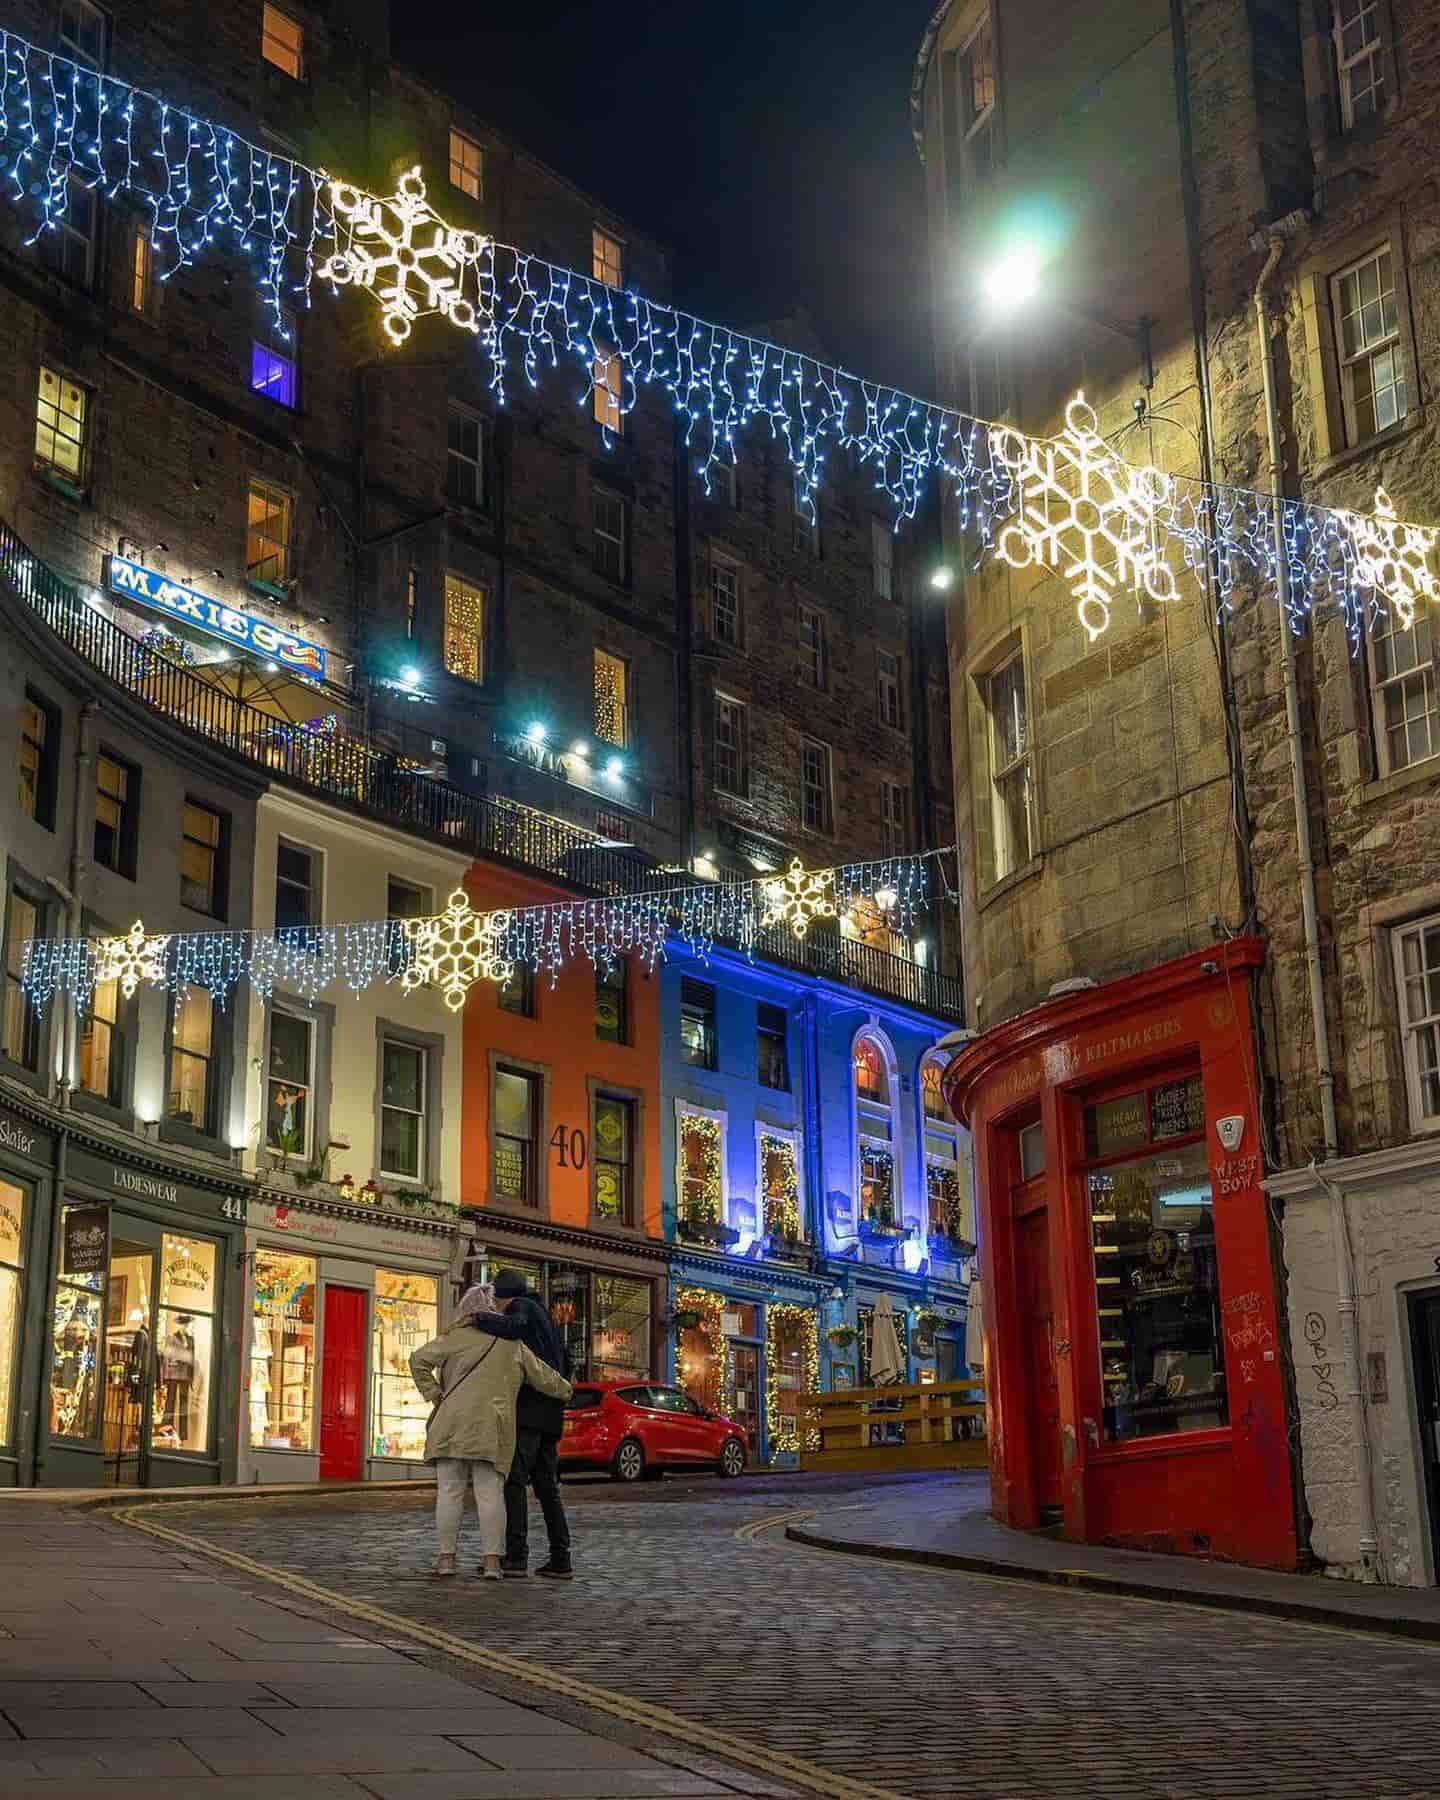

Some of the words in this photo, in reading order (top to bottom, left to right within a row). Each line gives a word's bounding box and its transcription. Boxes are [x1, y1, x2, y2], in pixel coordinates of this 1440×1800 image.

[0, 1119, 36, 1154] Slater
[550, 1124, 586, 1170] 40
[1215, 1155, 1257, 1178] WEST
[113, 1168, 177, 1202] LADIESWEAR
[1218, 1174, 1253, 1195] BOW
